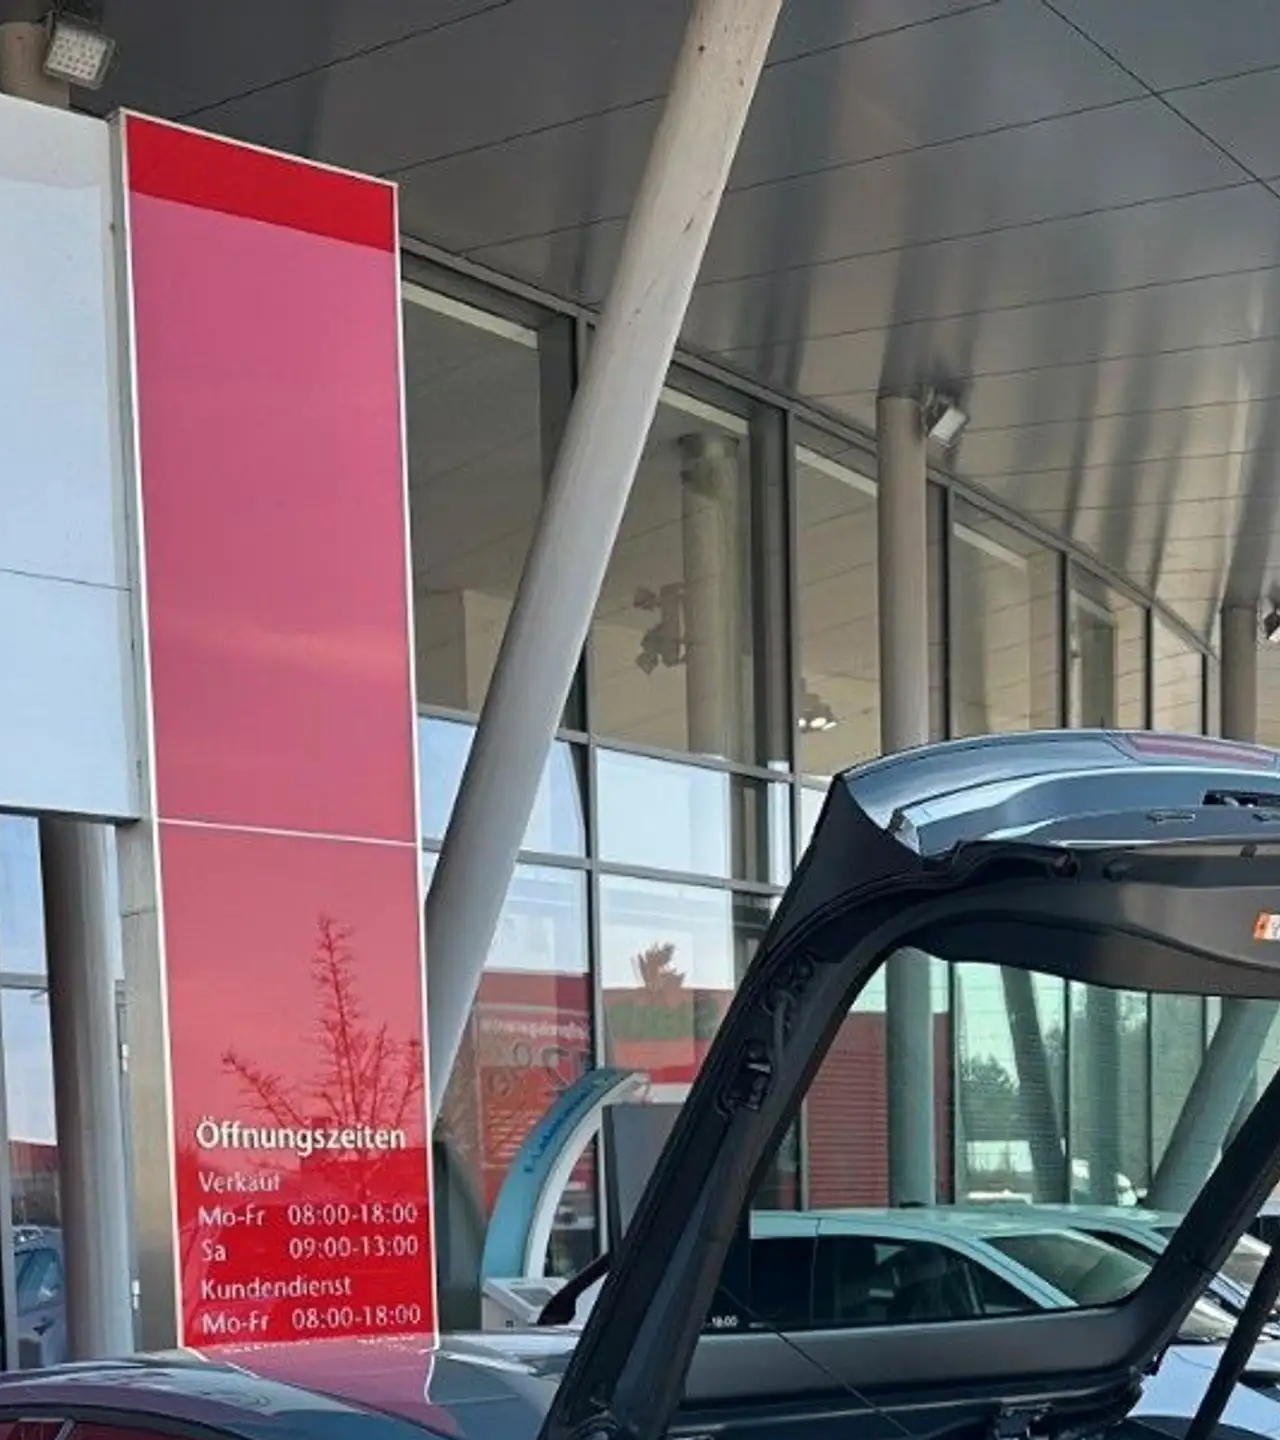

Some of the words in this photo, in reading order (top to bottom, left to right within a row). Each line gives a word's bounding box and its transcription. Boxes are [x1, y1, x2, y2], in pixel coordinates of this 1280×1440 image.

[195, 1116, 406, 1156] Öffnungszeiten
[198, 1171, 280, 1193] Verkauf
[198, 1203, 265, 1227] Mo-Fr
[287, 1203, 418, 1226] 08:00-18:00
[201, 1240, 227, 1262] Sa
[289, 1235, 418, 1259] 09:00-13:00
[201, 1274, 352, 1300] Kundendienst
[201, 1311, 270, 1335] Mo-Fr
[292, 1303, 421, 1330] 08:00-18:00
